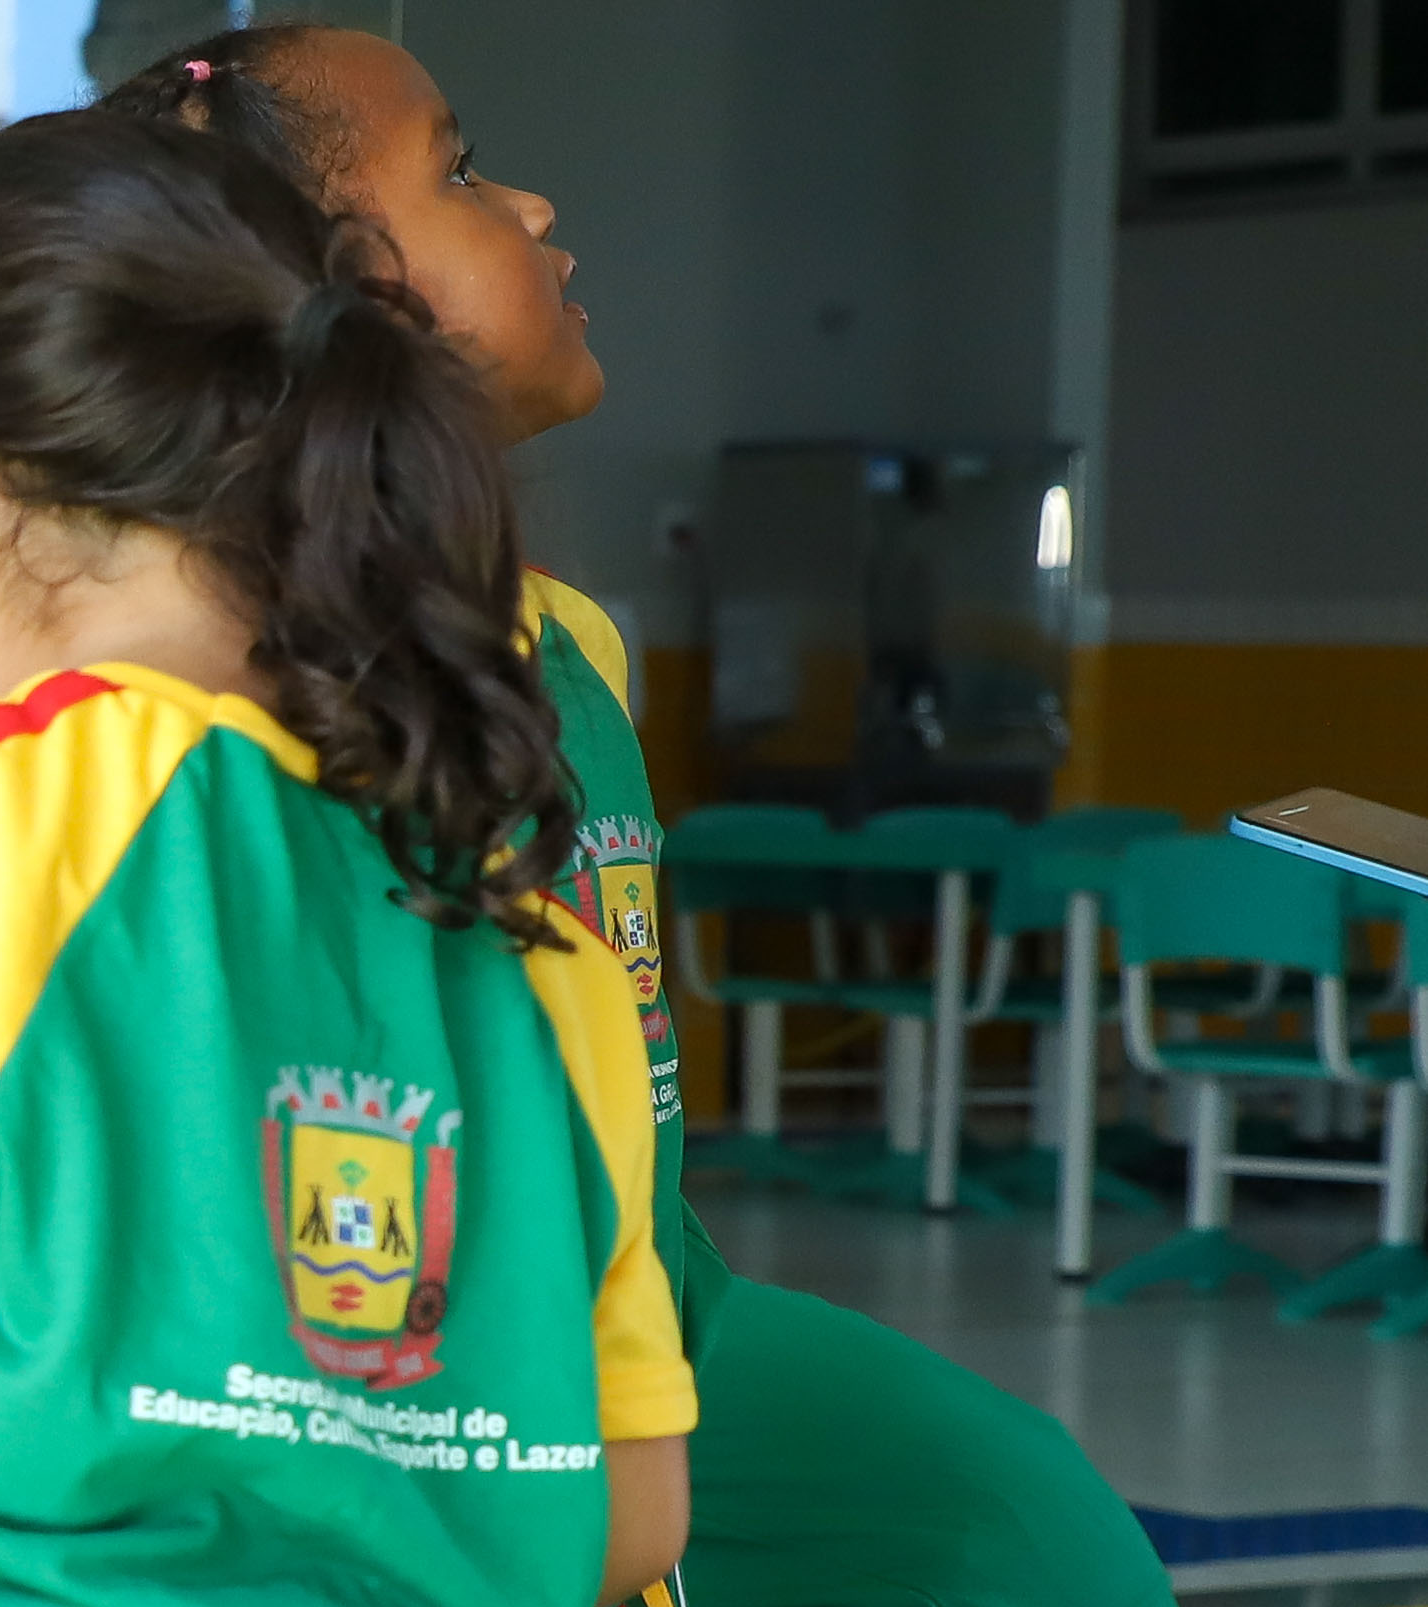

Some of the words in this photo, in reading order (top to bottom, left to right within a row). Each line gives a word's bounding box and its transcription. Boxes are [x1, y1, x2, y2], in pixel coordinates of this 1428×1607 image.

[130, 1384, 302, 1445] Educação,
[474, 1444, 500, 1471] e
[505, 1438, 602, 1471] Lazer
[462, 1406, 508, 1439] de
